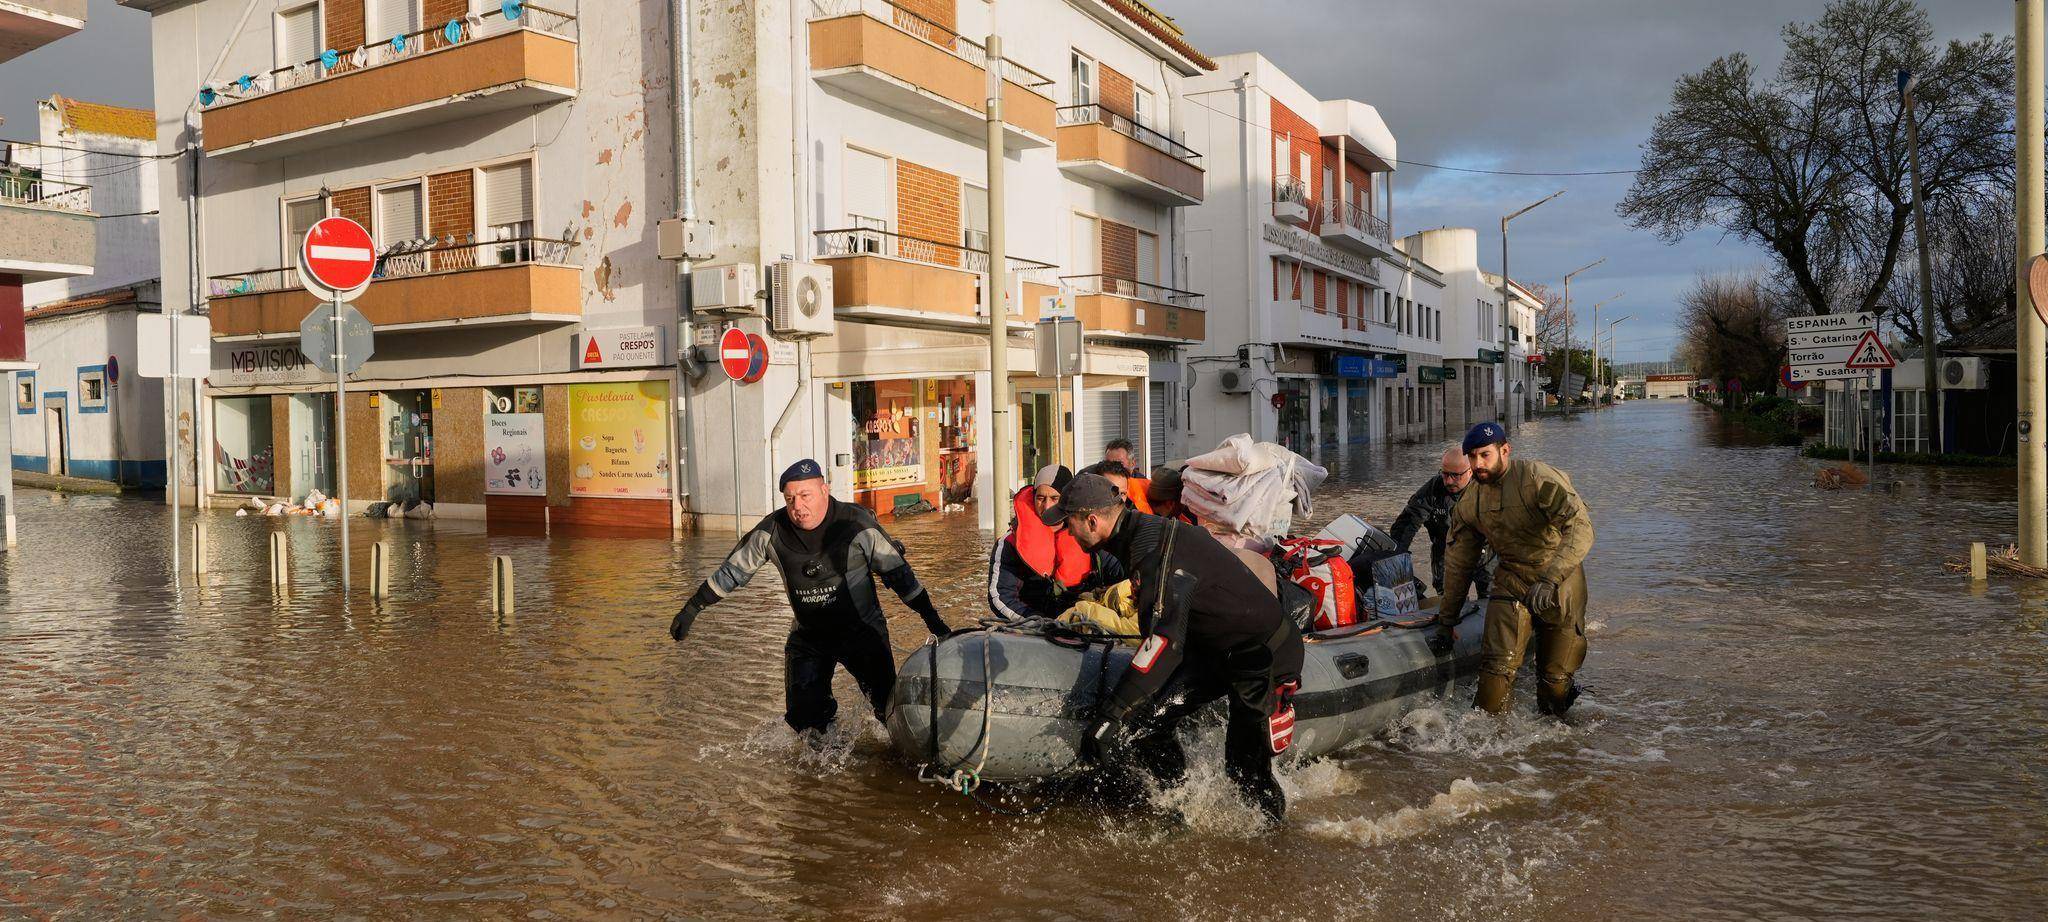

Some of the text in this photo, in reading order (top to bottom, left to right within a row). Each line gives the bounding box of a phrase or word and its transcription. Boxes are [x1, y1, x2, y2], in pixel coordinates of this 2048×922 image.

[1788, 317, 1848, 330] ESPANHA
[1812, 333, 1858, 344] Catarina
[620, 340, 654, 351] CRESPO'S
[1790, 352, 1825, 361] Torrão
[1816, 367, 1857, 377] Susana
[575, 389, 635, 403] Pastelaria
[491, 419, 507, 427] Doces
[502, 429, 528, 437] Regionais
[601, 434, 614, 442] Sopa
[634, 470, 653, 478] Assada
[801, 594, 830, 603] NORDIC
